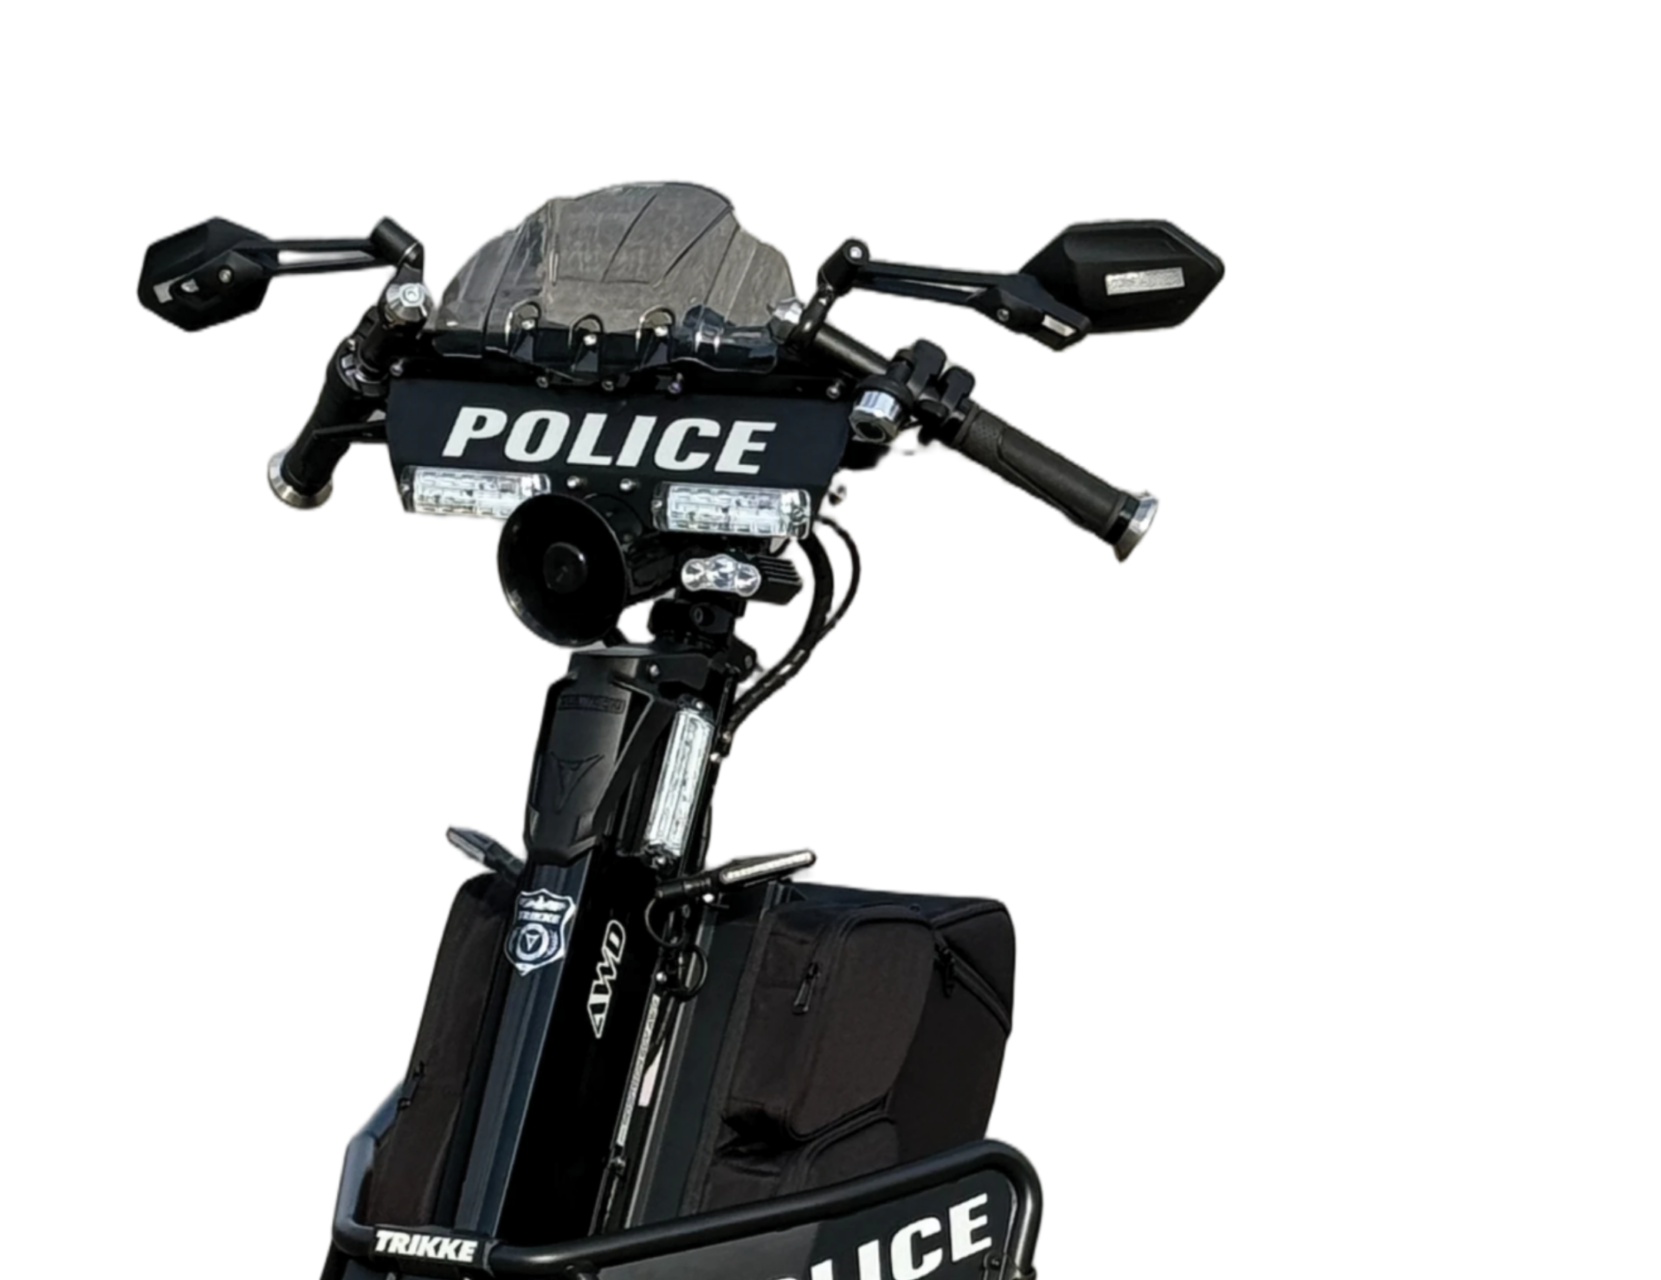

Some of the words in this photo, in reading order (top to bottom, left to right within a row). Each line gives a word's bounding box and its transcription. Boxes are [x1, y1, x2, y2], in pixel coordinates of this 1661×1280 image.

[443, 406, 777, 475] POLICE
[586, 919, 626, 1039] AWD
[375, 1229, 479, 1263] TRIKKE
